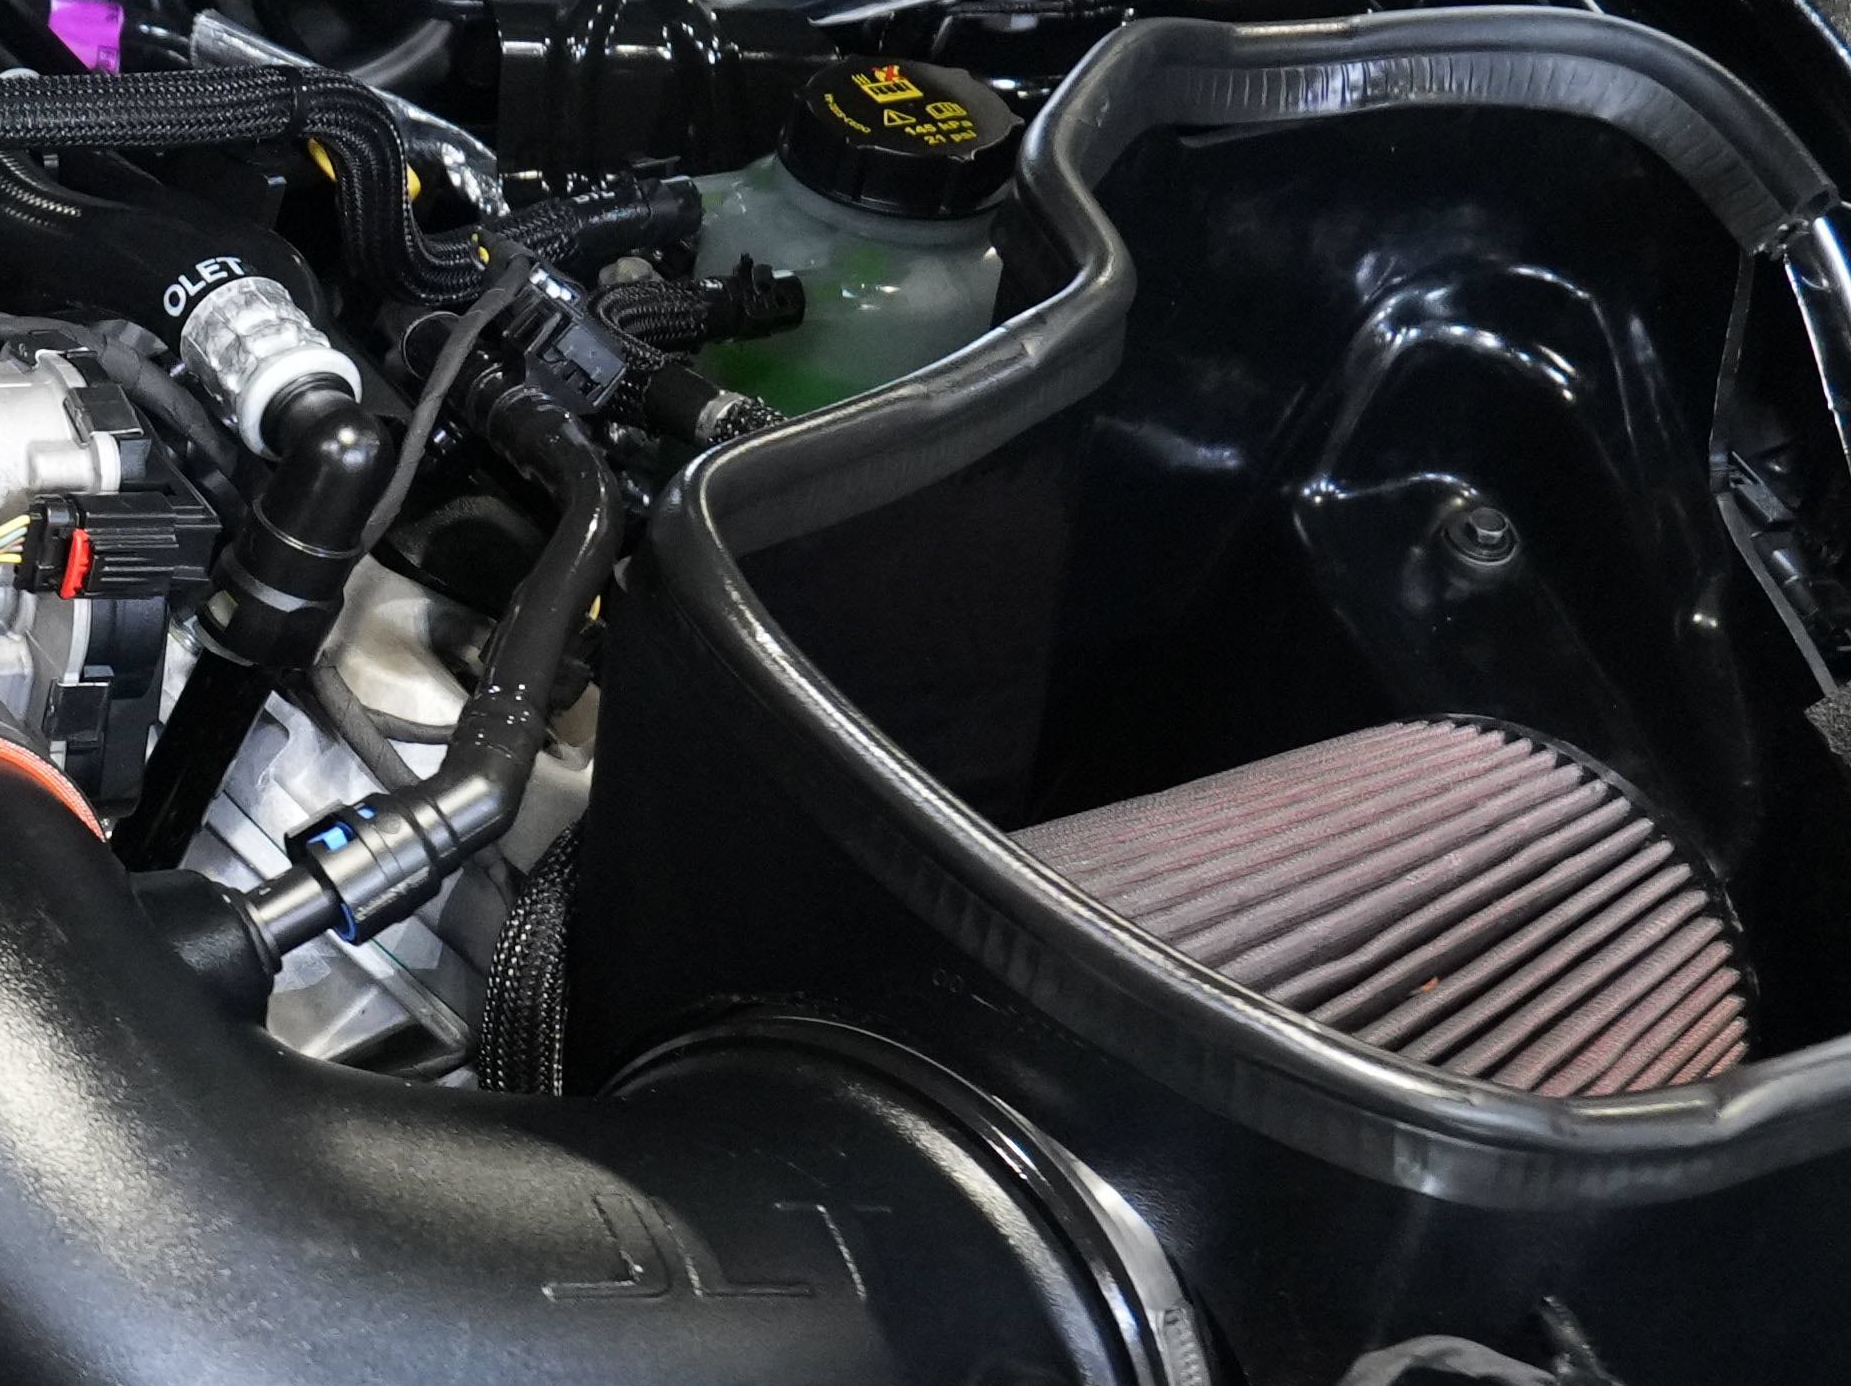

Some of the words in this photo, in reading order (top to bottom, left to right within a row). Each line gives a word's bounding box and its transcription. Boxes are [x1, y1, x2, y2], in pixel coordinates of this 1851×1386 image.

[904, 123, 938, 136] 145
[937, 119, 974, 132] kPa
[924, 134, 947, 146] 21
[950, 129, 978, 143] psi
[163, 256, 245, 318] OLET
